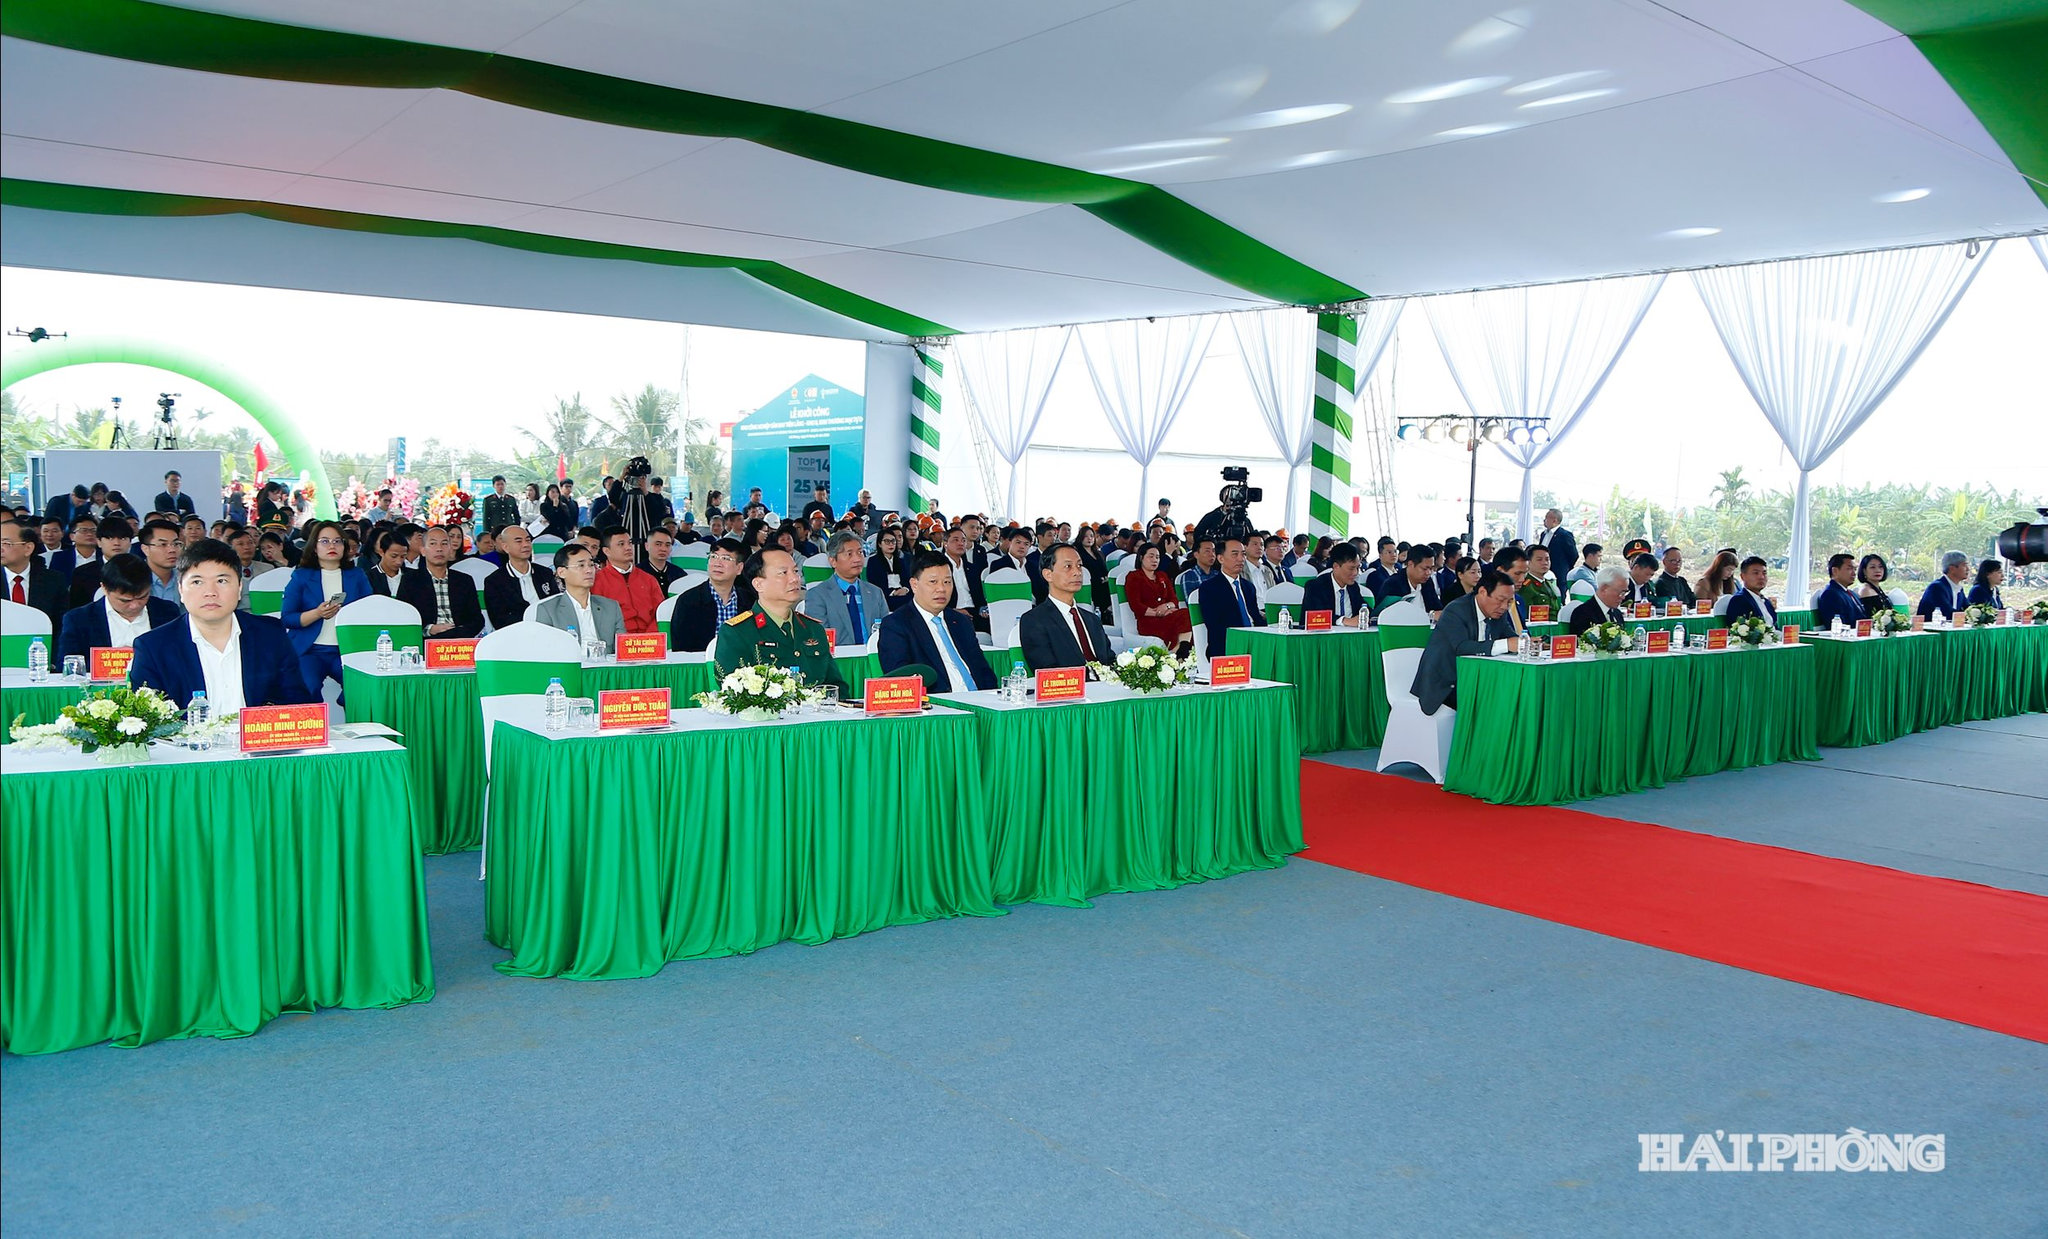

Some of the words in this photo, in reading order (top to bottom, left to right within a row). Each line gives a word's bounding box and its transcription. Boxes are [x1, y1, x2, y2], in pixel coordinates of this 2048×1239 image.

[797, 457, 816, 467] TOP
[793, 478, 811, 493] 25
[244, 721, 272, 733] HOÀNG
[274, 721, 296, 731] MINH
[297, 718, 324, 730] CƯỜNG
